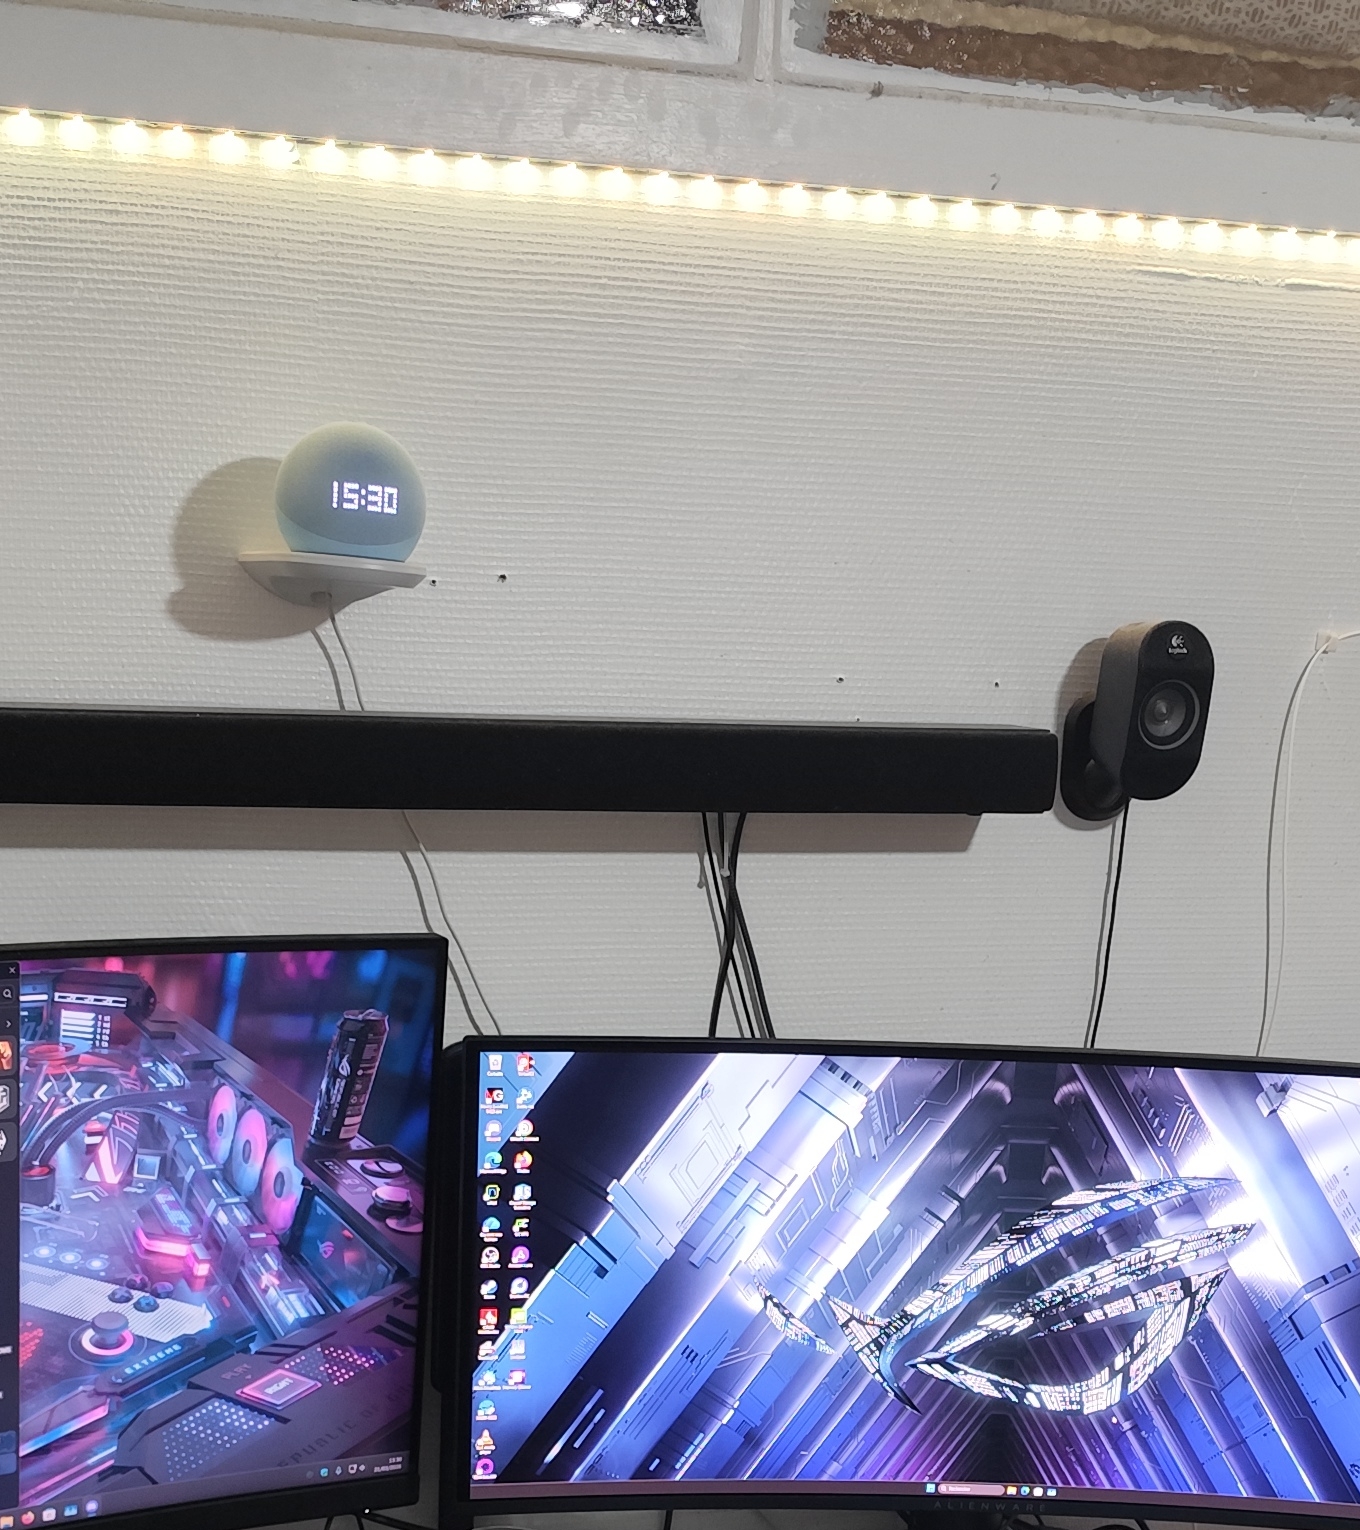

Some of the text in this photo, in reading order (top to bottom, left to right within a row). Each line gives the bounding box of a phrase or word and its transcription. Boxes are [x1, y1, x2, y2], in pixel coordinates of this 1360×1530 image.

[332, 480, 398, 515] 15:30
[124, 1343, 182, 1375] EXTREME
[934, 1501, 1046, 1512] ALIENWARE
